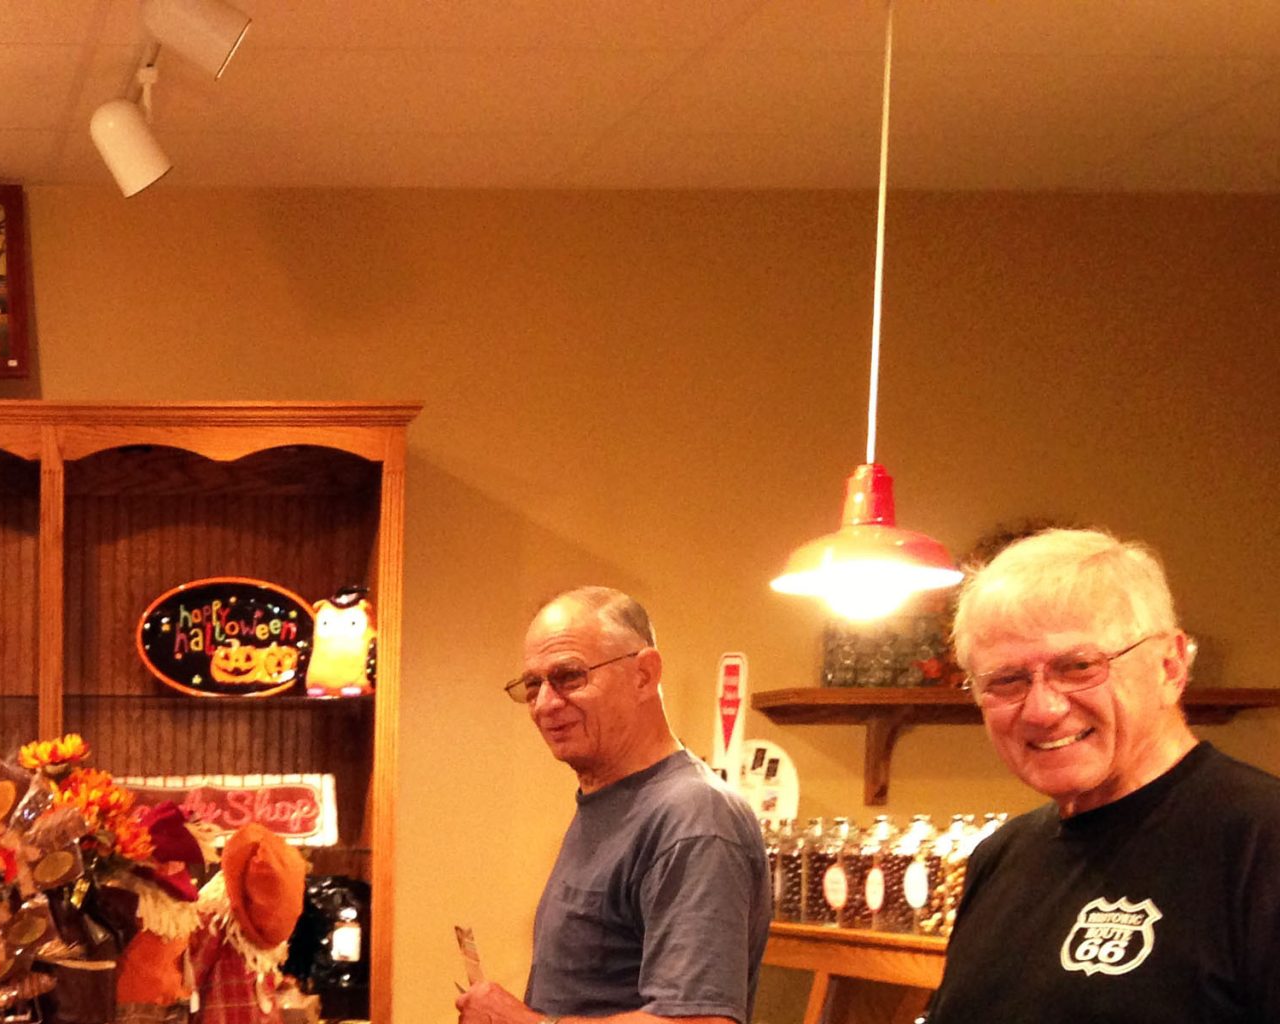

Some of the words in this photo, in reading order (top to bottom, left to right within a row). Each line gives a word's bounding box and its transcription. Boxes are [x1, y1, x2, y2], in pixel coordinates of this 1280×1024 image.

[179, 600, 231, 627] happy
[173, 618, 297, 655] halloween
[223, 788, 319, 832] Shop
[1084, 927, 1134, 941] ROUTE
[1075, 938, 1129, 963] 66
